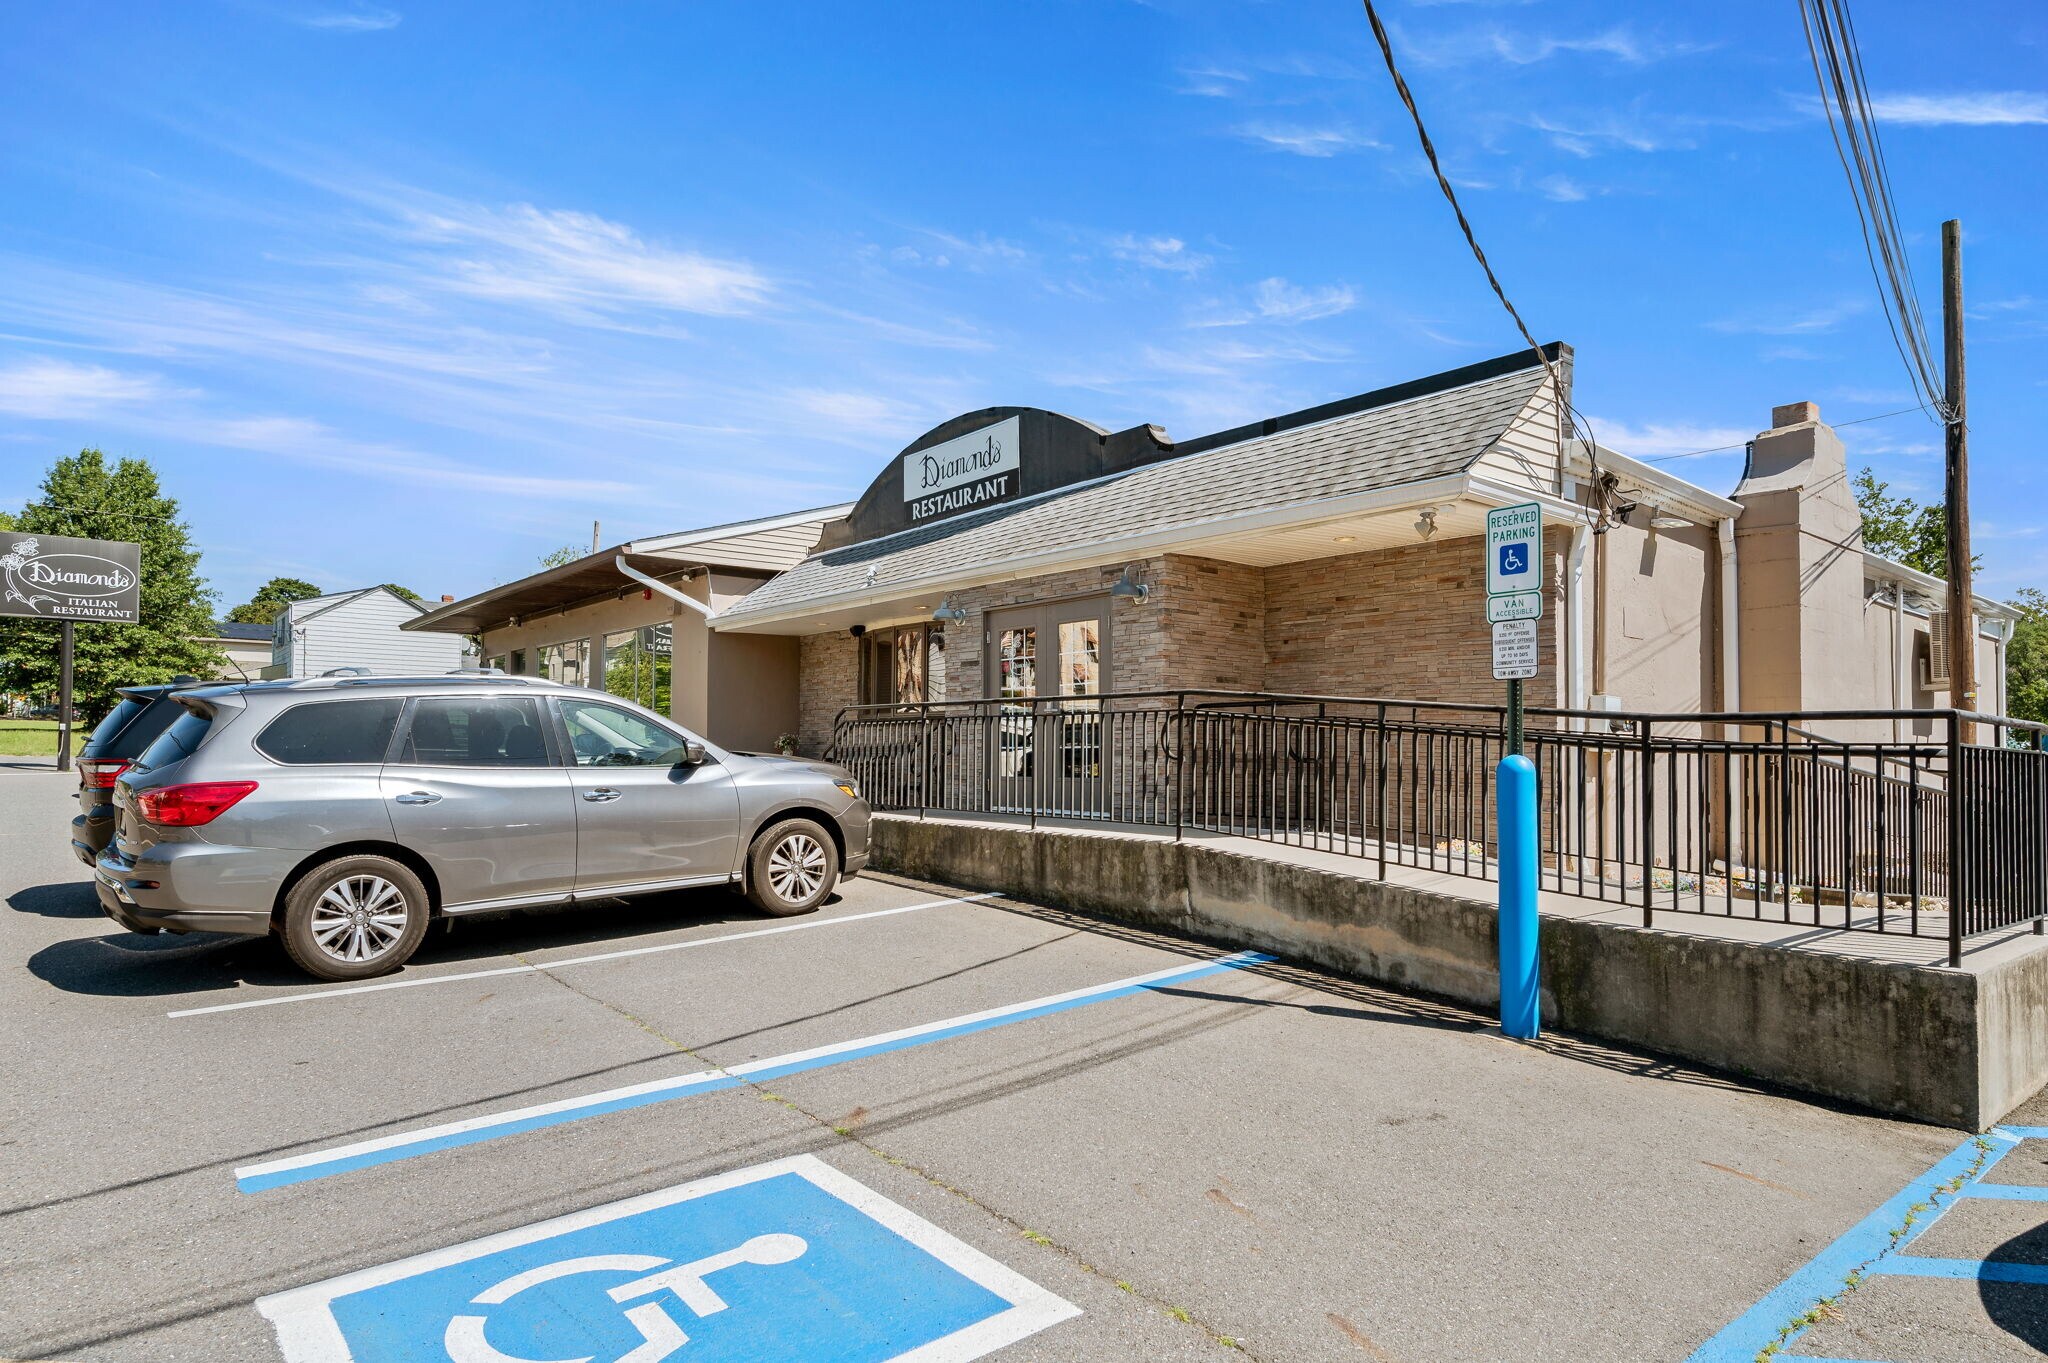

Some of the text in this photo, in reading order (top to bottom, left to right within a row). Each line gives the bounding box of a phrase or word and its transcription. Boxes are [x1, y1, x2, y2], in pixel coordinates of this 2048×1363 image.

[912, 475, 1008, 520] RESTAURANT
[1491, 511, 1536, 528] RESERVED
[1493, 526, 1535, 542] PARKING
[68, 597, 118, 608] ITALIAN
[1504, 600, 1524, 608] VAN
[53, 605, 133, 618] RESTAURANT
[1496, 608, 1533, 617] ACCESSIBLE
